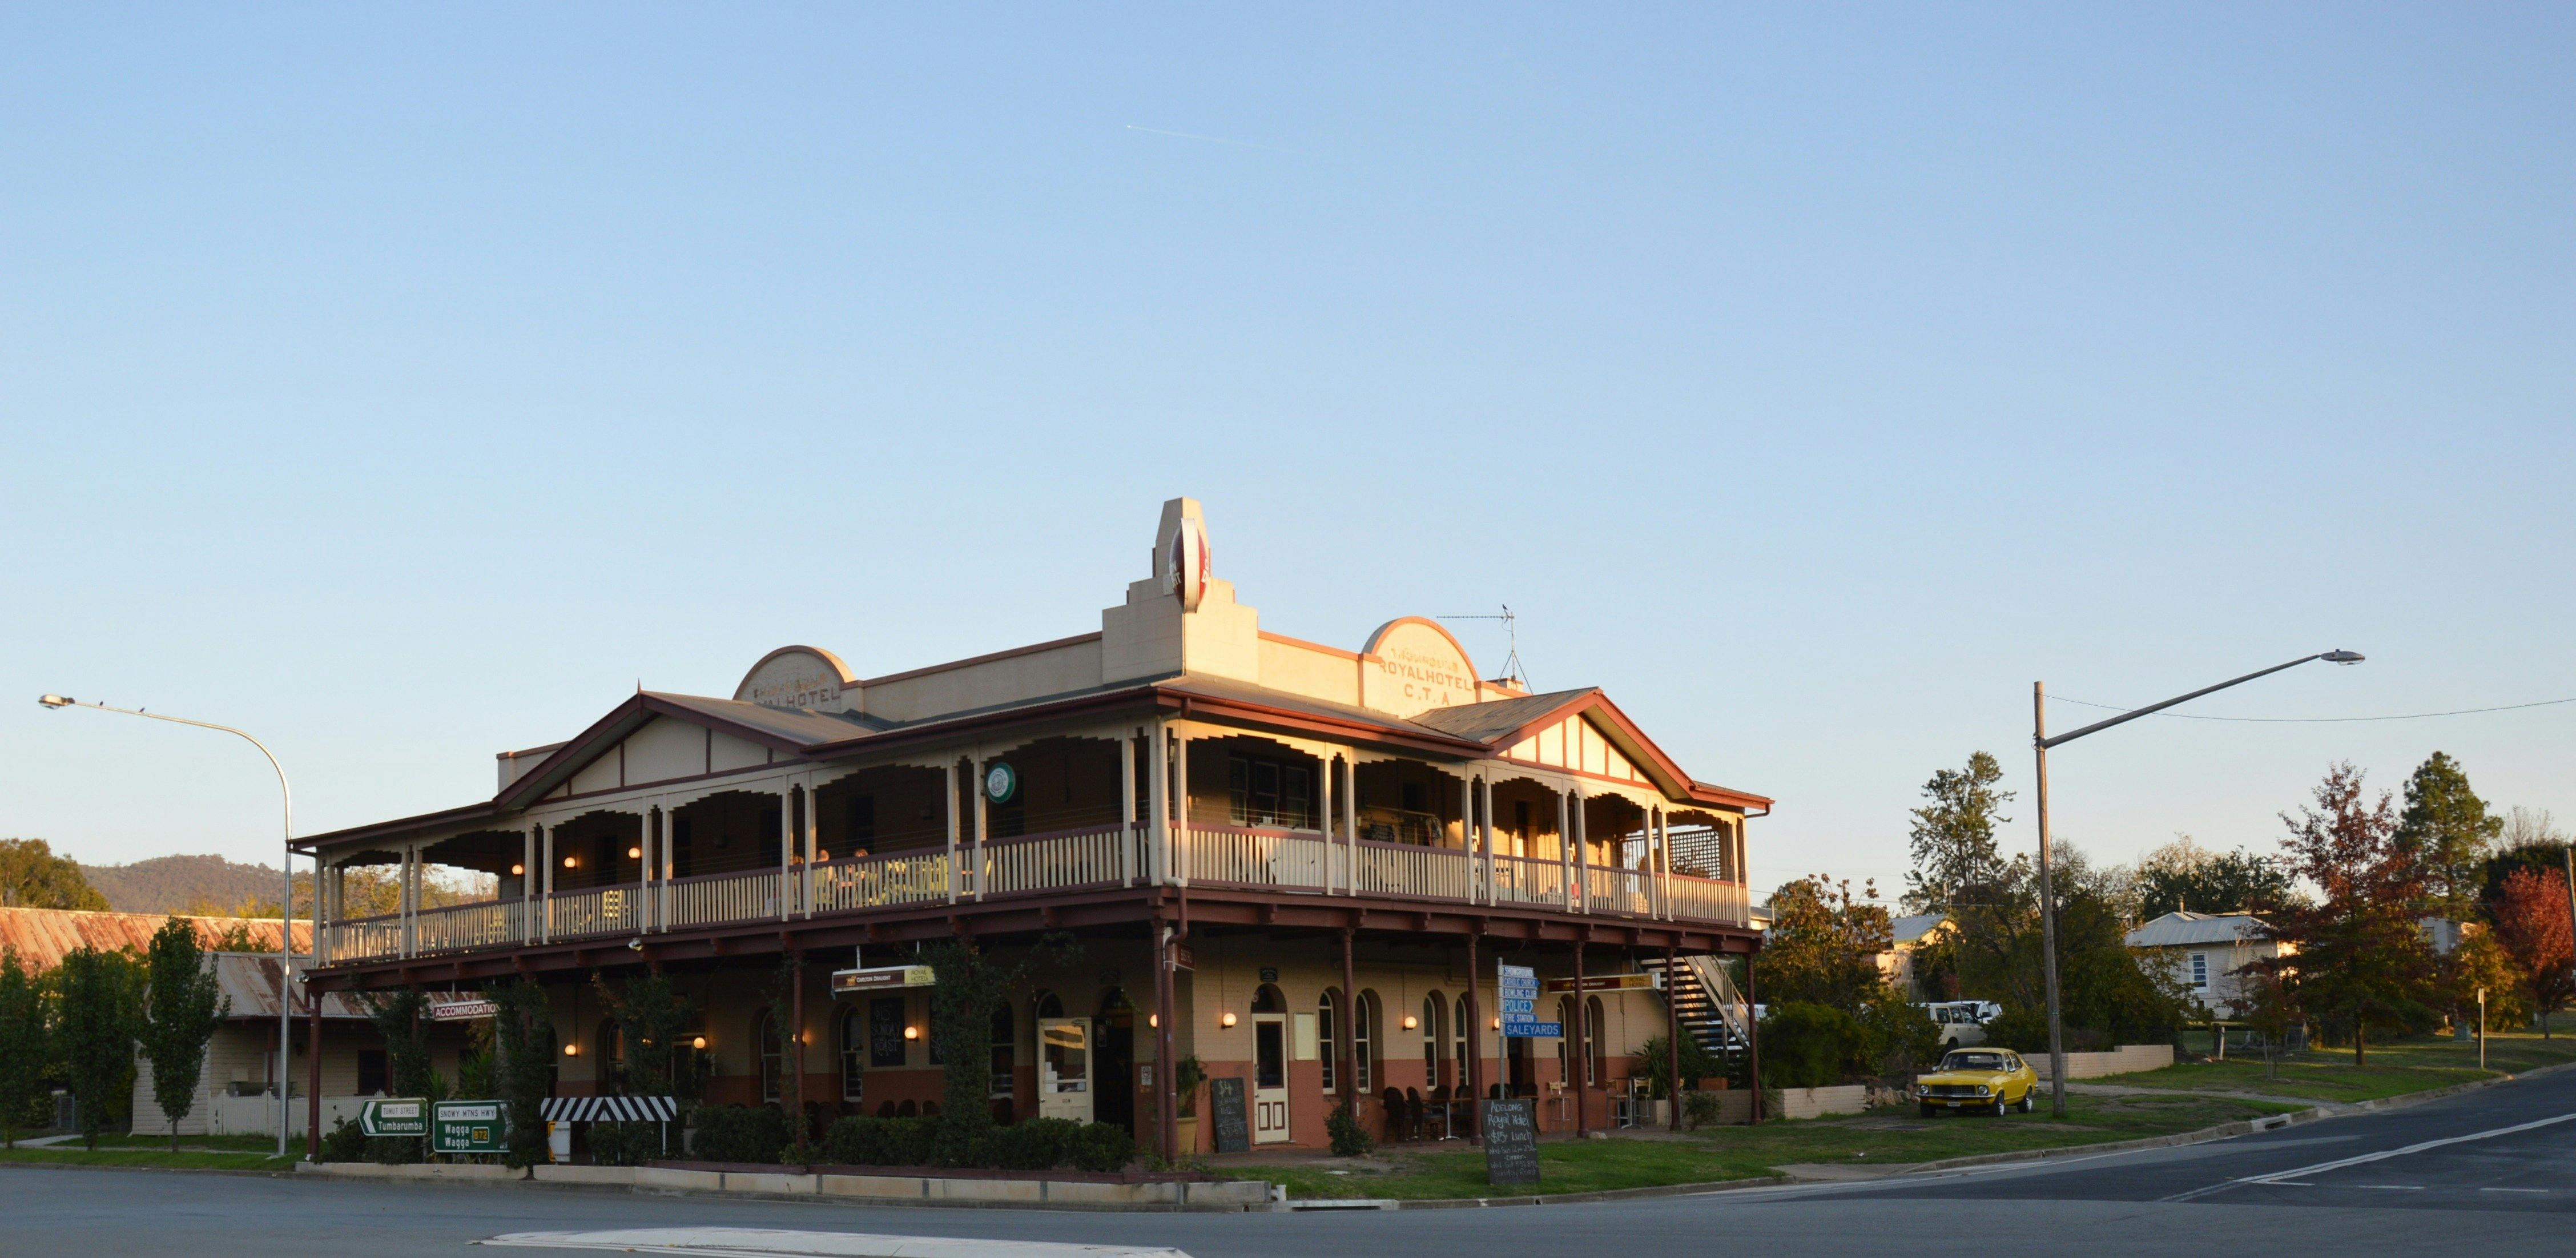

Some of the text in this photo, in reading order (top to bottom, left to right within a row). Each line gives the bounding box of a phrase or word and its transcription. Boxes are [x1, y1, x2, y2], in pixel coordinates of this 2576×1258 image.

[786, 688, 841, 708] HOTEL
[1504, 988, 1537, 998] BOWLING CLUB
[436, 1004, 496, 1016] ACCOMMODATIO
[1505, 999, 1530, 1012] POLICE
[1505, 1014, 1534, 1023] FIRE STATION
[1507, 1025, 1559, 1035] SALEYARDS
[378, 1121, 422, 1131] Tumbarumba
[1488, 1113, 1511, 1129] Royal
[445, 1124, 469, 1136] Wagga
[474, 1131, 488, 1140] B72
[1512, 1129, 1533, 1145] Lunch
[445, 1137, 469, 1150] Wagga
